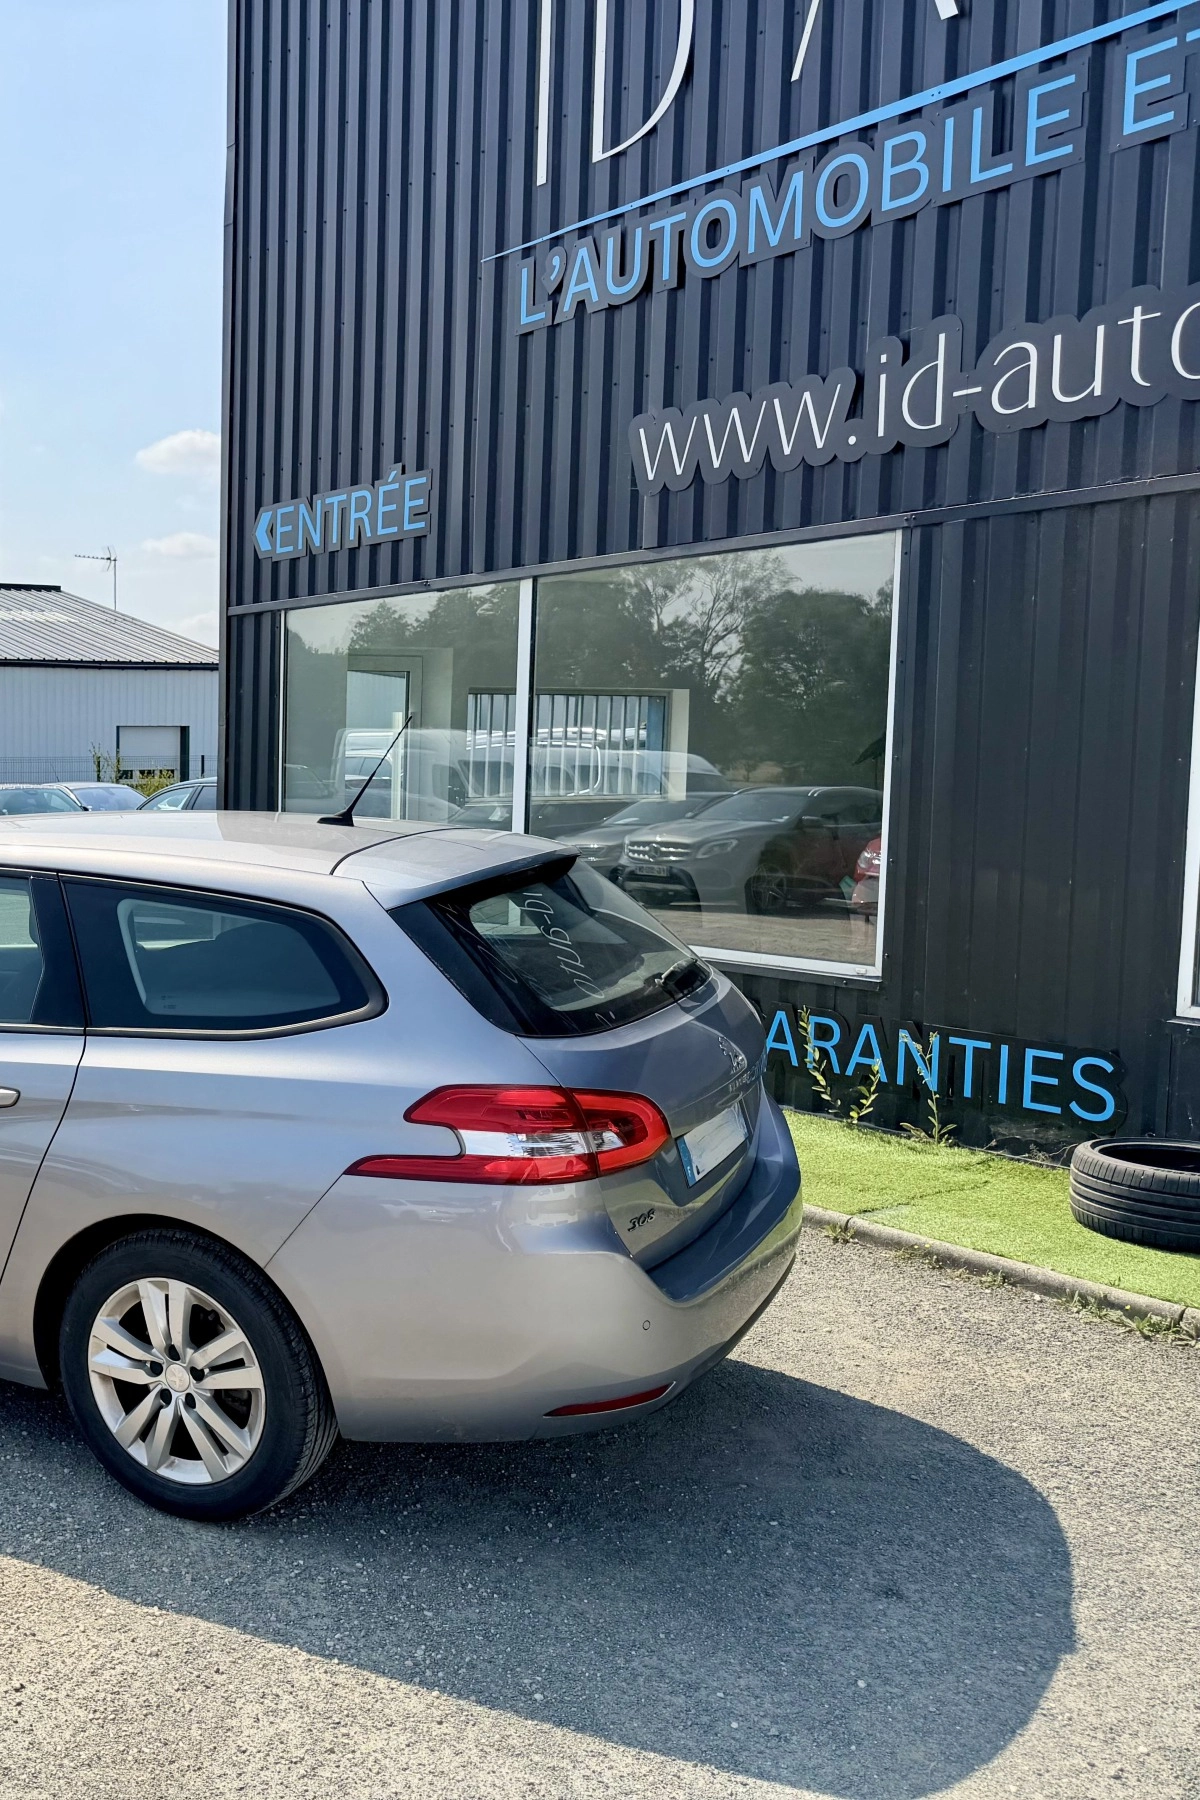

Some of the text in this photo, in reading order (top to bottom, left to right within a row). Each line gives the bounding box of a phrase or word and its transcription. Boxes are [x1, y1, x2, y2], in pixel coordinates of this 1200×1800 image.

[520, 74, 1076, 325] L'AUTOMOBILE
[1122, 28, 1200, 136] E
[275, 471, 427, 554] ENTRÉE
[766, 1010, 1115, 1122] ARANTIES
[627, 1208, 656, 1232] 308
